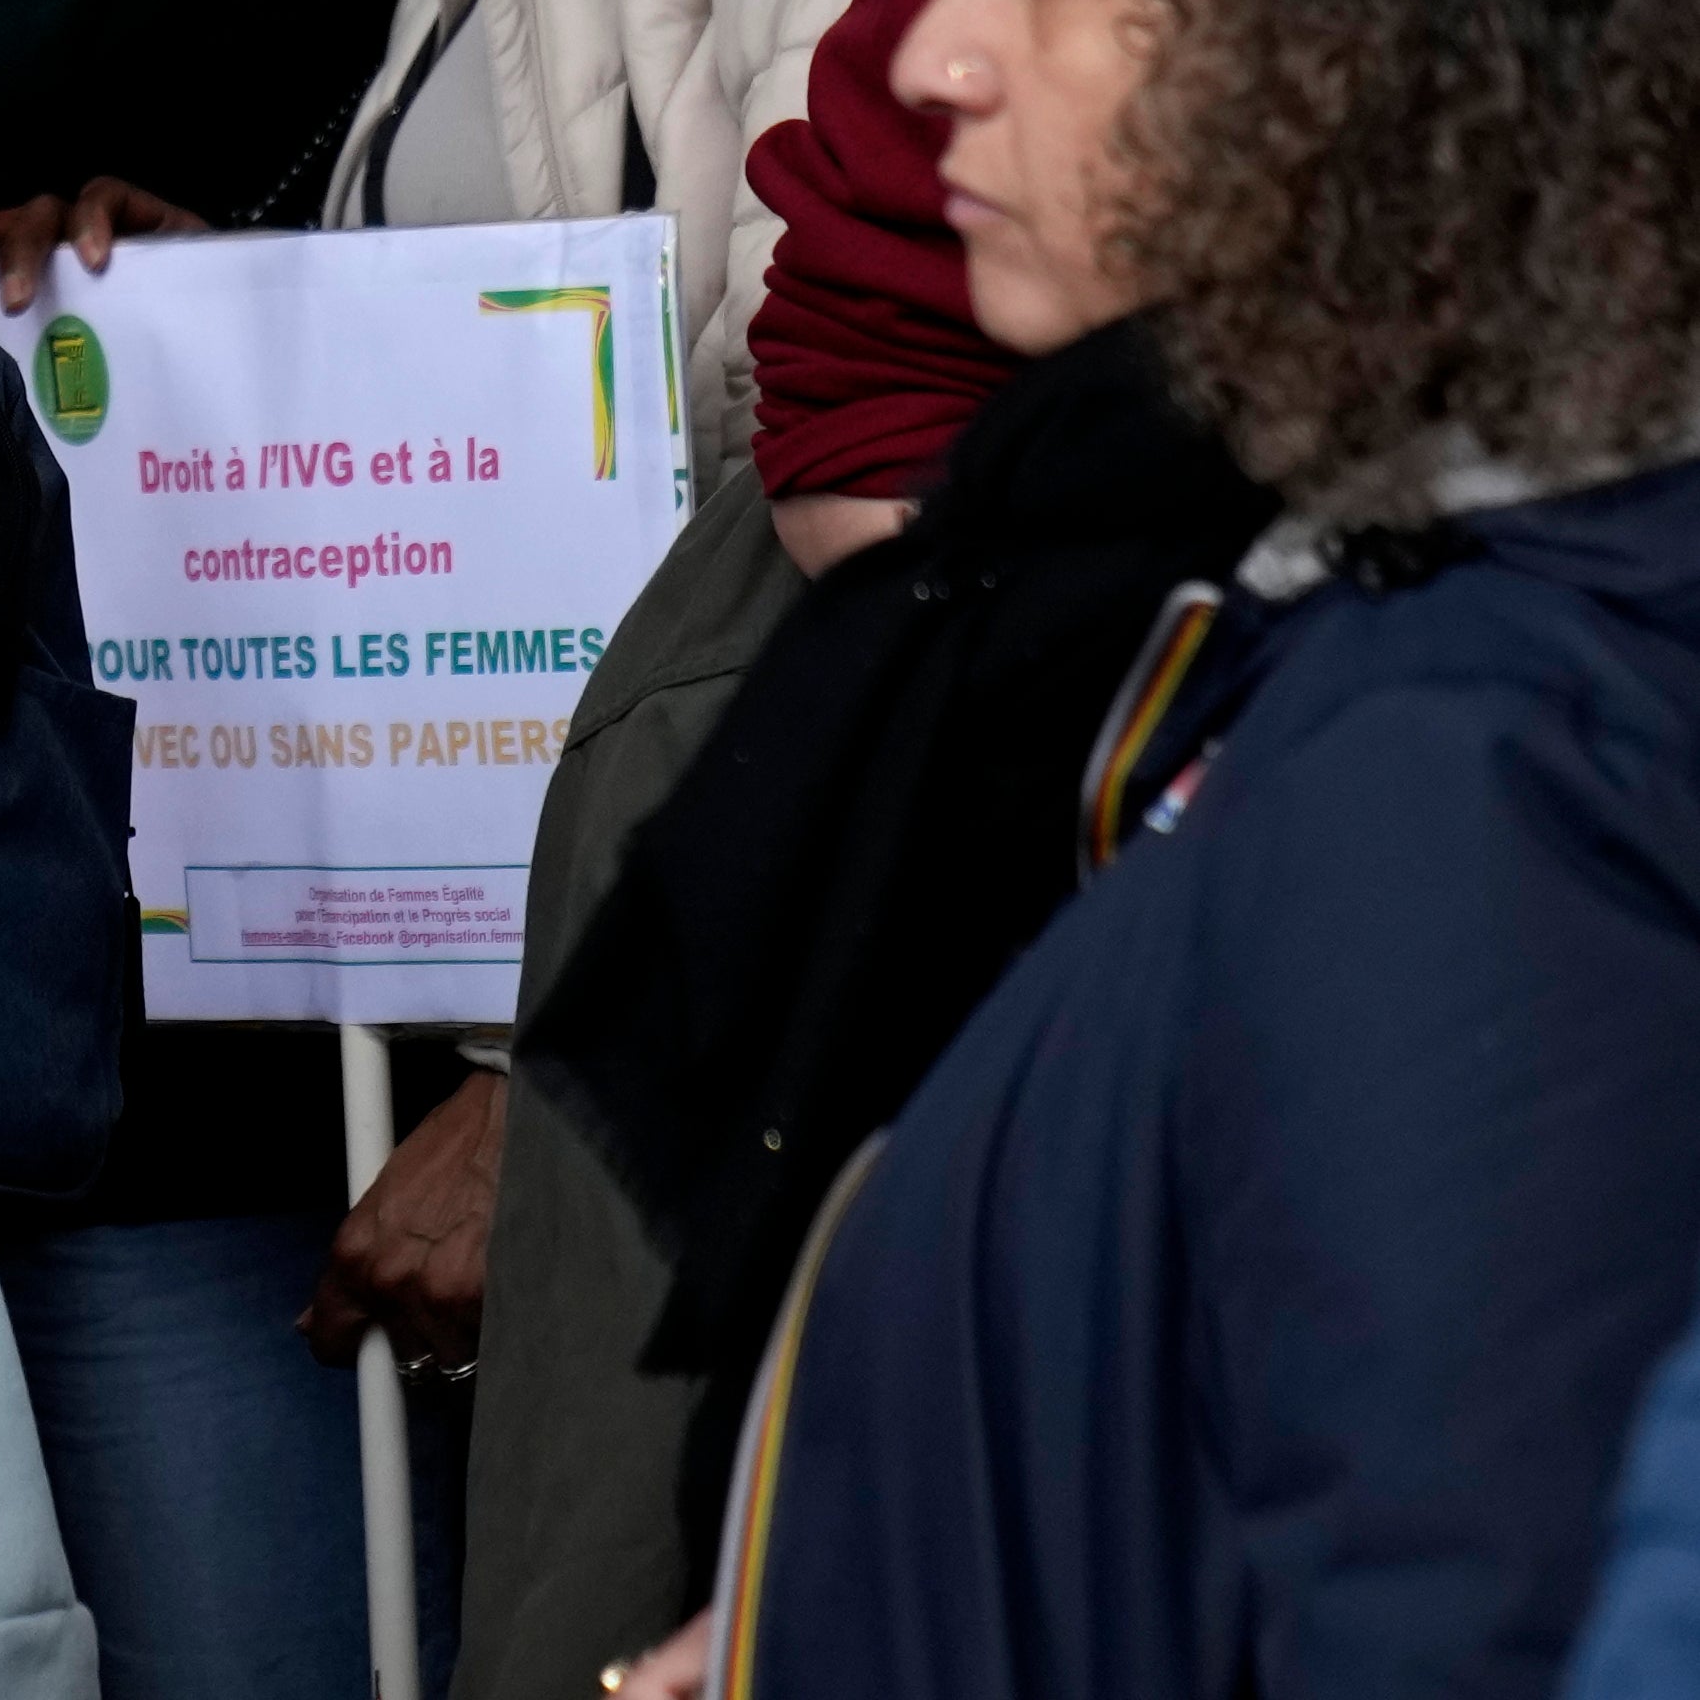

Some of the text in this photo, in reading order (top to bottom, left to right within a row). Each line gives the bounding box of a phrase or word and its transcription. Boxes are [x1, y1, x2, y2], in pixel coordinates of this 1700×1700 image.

[138, 436, 500, 494] Droit à l'IVG et à la
[183, 531, 452, 589] contraception
[88, 627, 606, 683] OUR TOUTES LES FEMMES
[134, 717, 572, 770] VEC OU SANS PAPIERS
[370, 888, 385, 903] de
[393, 909, 405, 924] et
[408, 909, 419, 923] le
[422, 908, 470, 926] Progrès
[474, 908, 511, 922] social
[336, 930, 394, 946] Facebook
